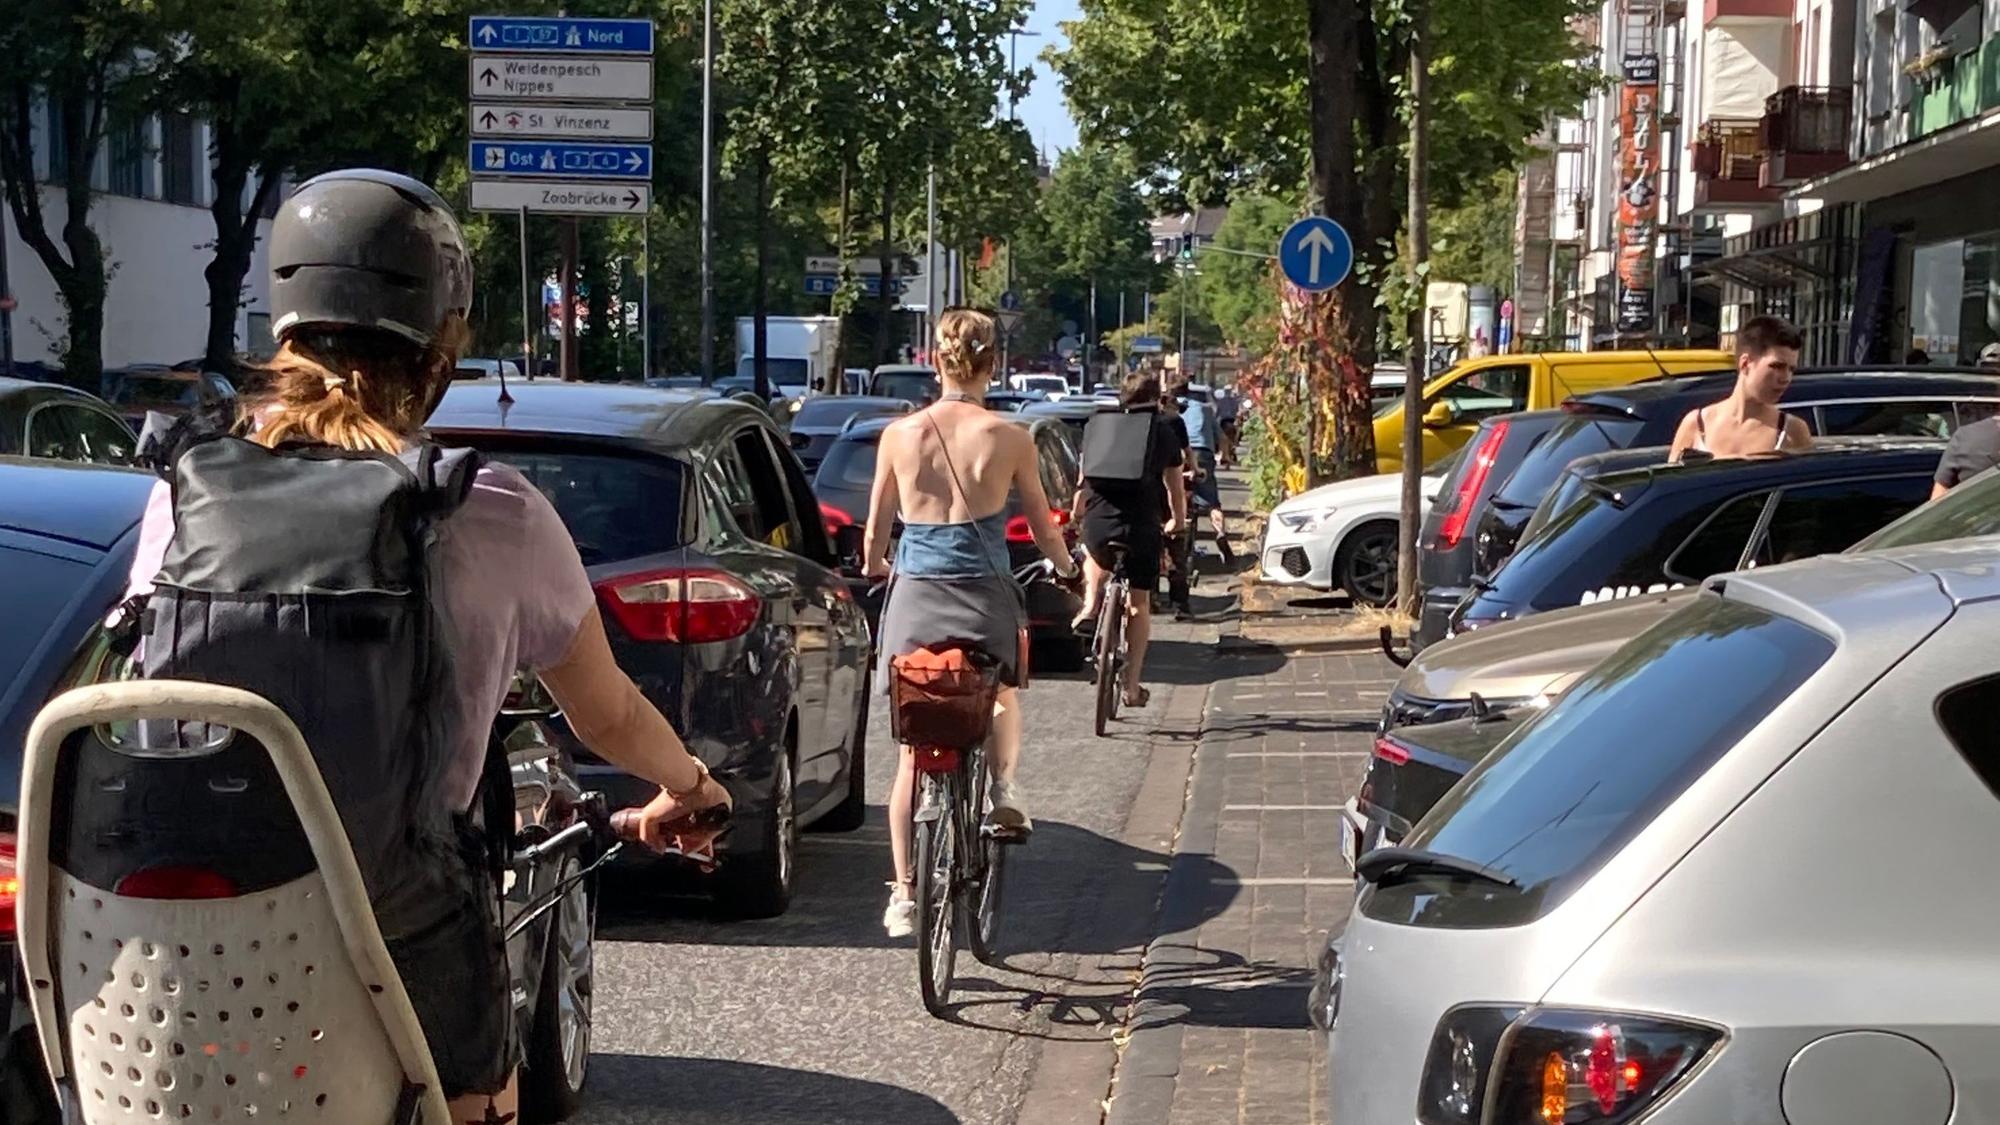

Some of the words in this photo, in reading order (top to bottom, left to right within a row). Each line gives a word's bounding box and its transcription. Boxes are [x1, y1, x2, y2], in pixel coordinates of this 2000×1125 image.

[587, 29, 624, 44] Nord
[504, 62, 601, 77] Weidenpesch
[504, 79, 554, 95] Nippes
[554, 115, 611, 130] Vinzenz
[509, 152, 535, 166] Ost
[541, 190, 617, 206] Zoobrücke
